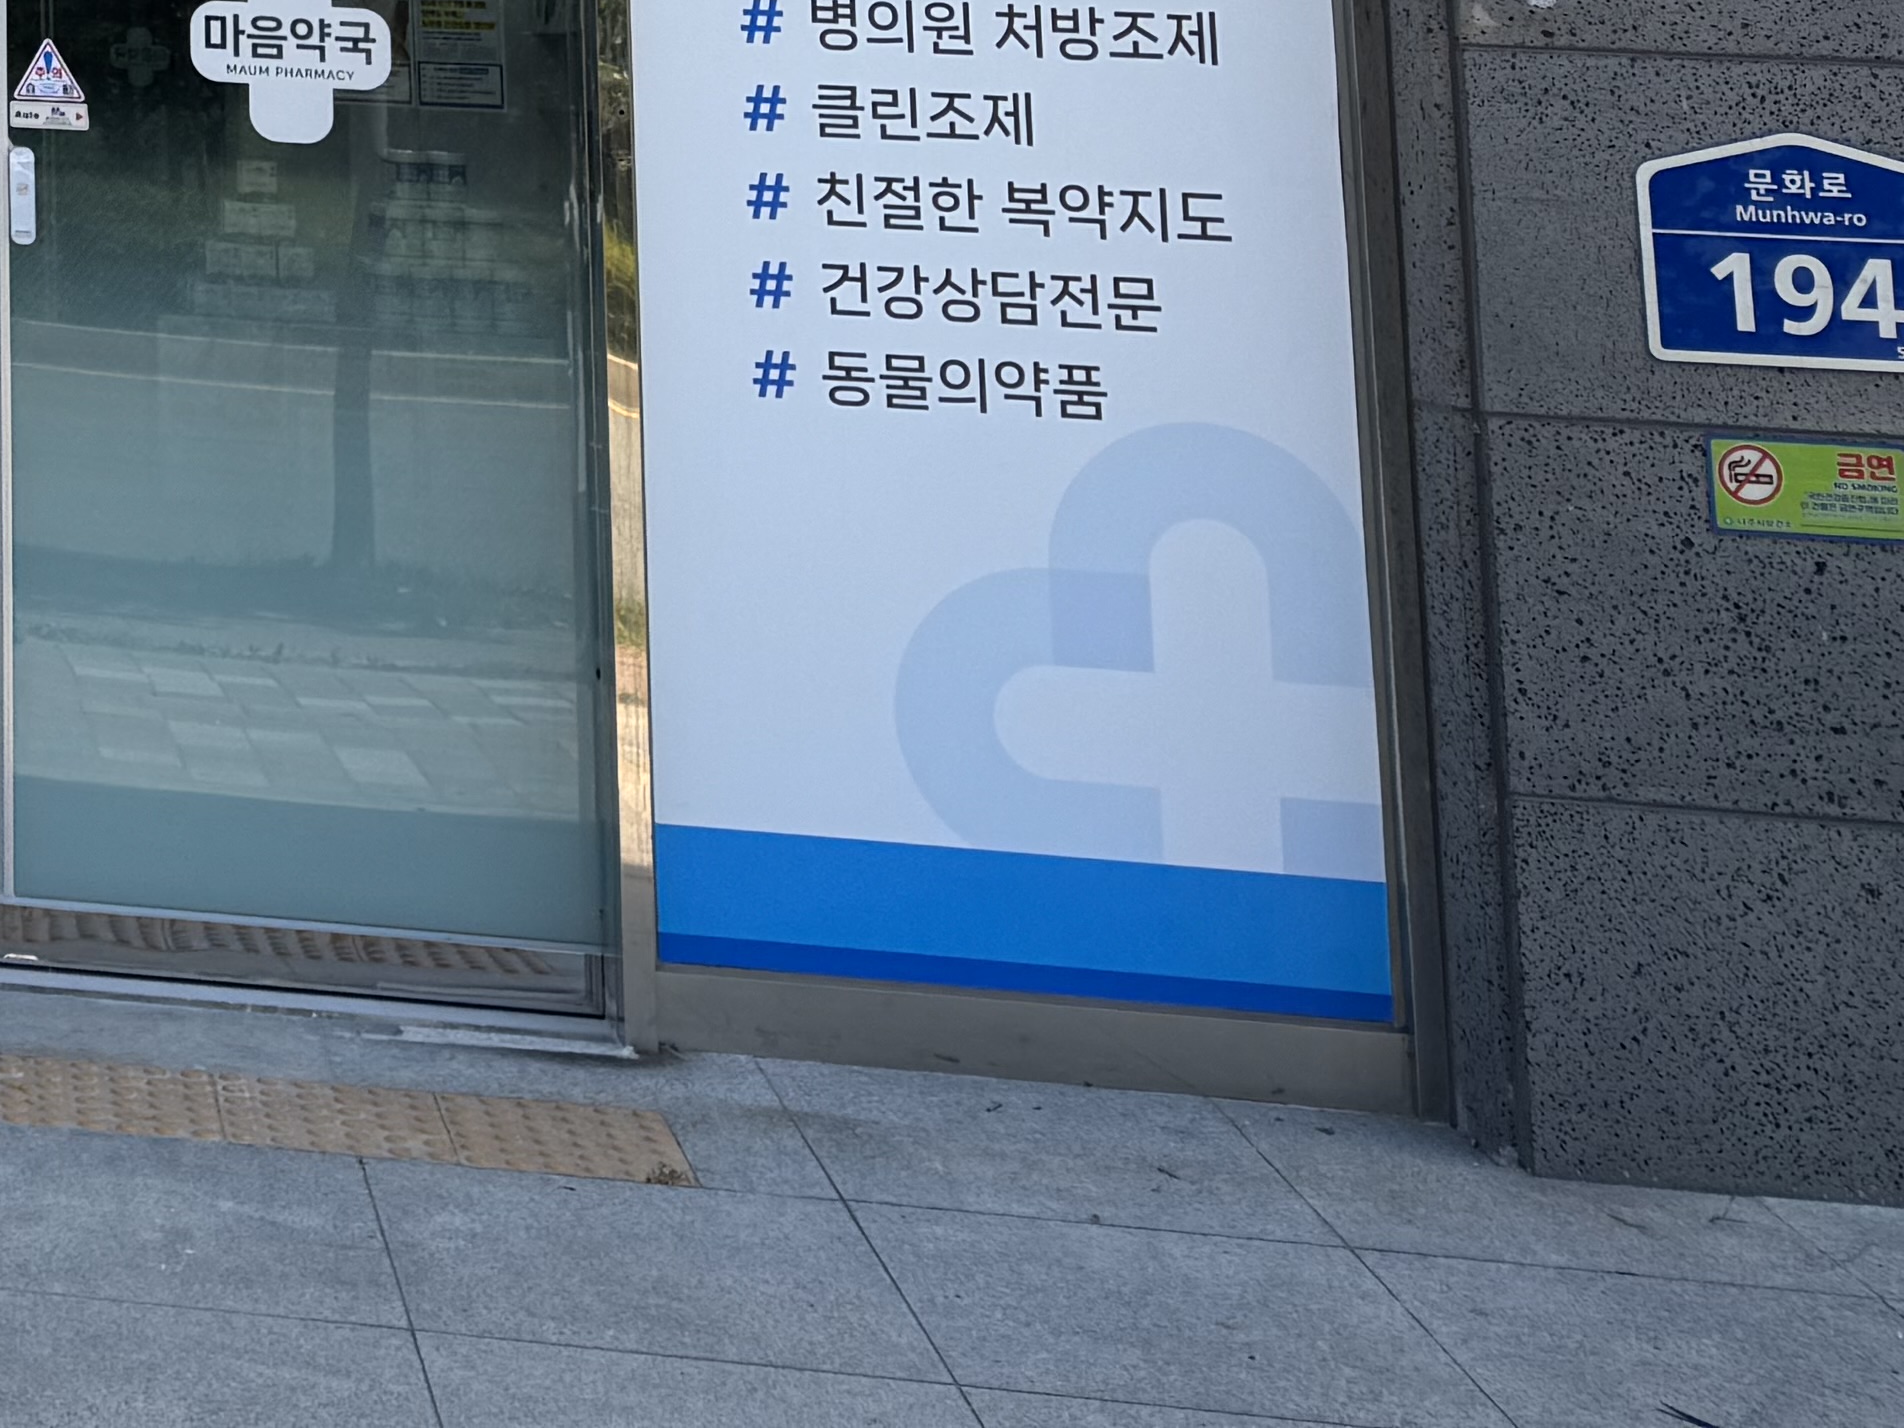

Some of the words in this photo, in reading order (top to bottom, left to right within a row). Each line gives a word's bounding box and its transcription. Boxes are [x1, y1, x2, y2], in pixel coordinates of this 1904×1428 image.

[204, 14, 377, 65] 마음약국
[992, 0, 1222, 67] 처방조제
[226, 64, 271, 78] MAUM
[275, 65, 355, 83] PHARMACY
[743, 83, 787, 133] #
[810, 82, 1038, 148] 클린조제
[746, 171, 790, 221] #
[815, 169, 984, 234] 친절한
[1001, 177, 1235, 245] 복약지도
[1735, 204, 1867, 228] Munhwa-ro
[1744, 168, 1853, 202] 문화로
[749, 260, 794, 309] #
[820, 260, 1164, 333] 건강상담전문
[1710, 251, 1904, 340] 194
[752, 349, 797, 398] #
[822, 350, 1110, 421] 동물의약품
[1837, 453, 1896, 481] 금연
